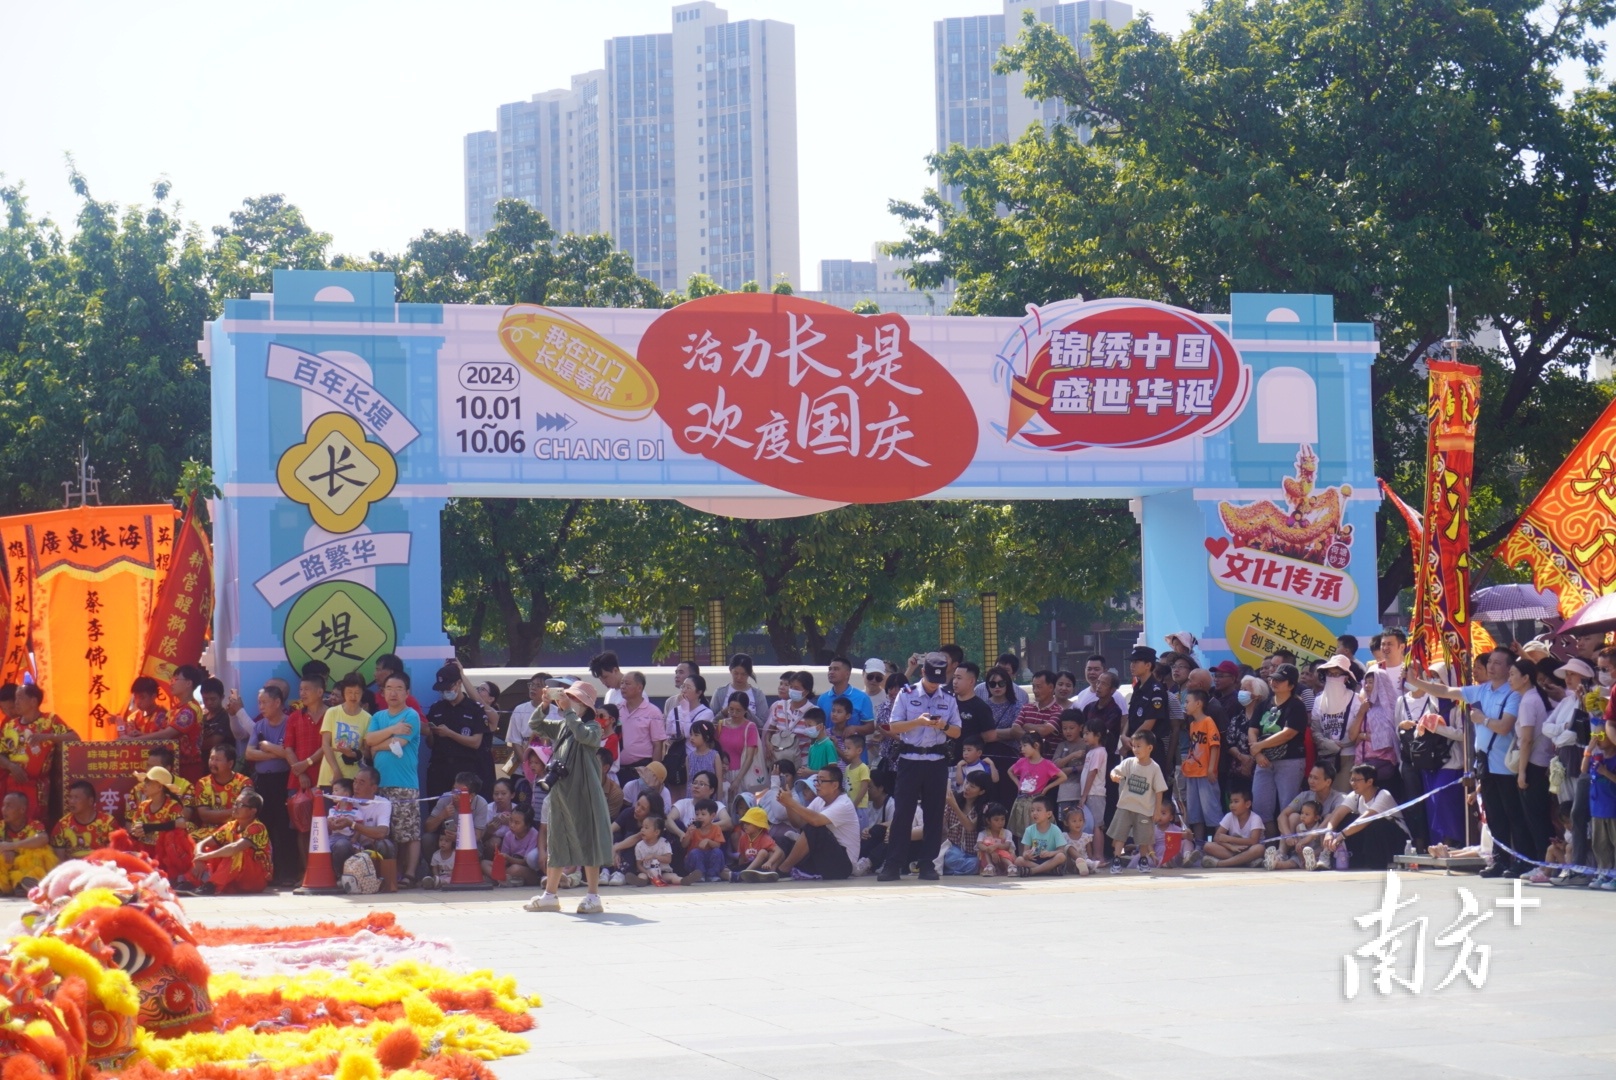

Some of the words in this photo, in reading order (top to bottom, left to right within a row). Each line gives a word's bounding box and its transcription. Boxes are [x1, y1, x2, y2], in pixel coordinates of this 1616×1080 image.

[535, 344, 616, 402] 长堤等你
[543, 324, 627, 384] 我在江门
[681, 311, 923, 395] 活力长堤
[1049, 329, 1214, 371] 锦绣中国
[293, 355, 395, 432] 百年长堤
[466, 366, 514, 386] 2024
[1049, 376, 1215, 417] 盛世华诞
[456, 395, 522, 420] 10.01
[686, 385, 932, 468] 欢度国庆
[456, 429, 526, 454] 10.06
[534, 437, 631, 462] CHANG
[637, 438, 665, 462] DI
[308, 444, 368, 497] 长
[40, 523, 144, 555] 廣東珠海
[279, 539, 377, 587] 一路繁华
[1220, 553, 1344, 602] 文化传承
[84, 590, 111, 728] 蔡李佛拳會
[311, 611, 365, 661] 堤
[1250, 612, 1338, 658] 大学生文创产品
[312, 821, 320, 852] 江门公安
